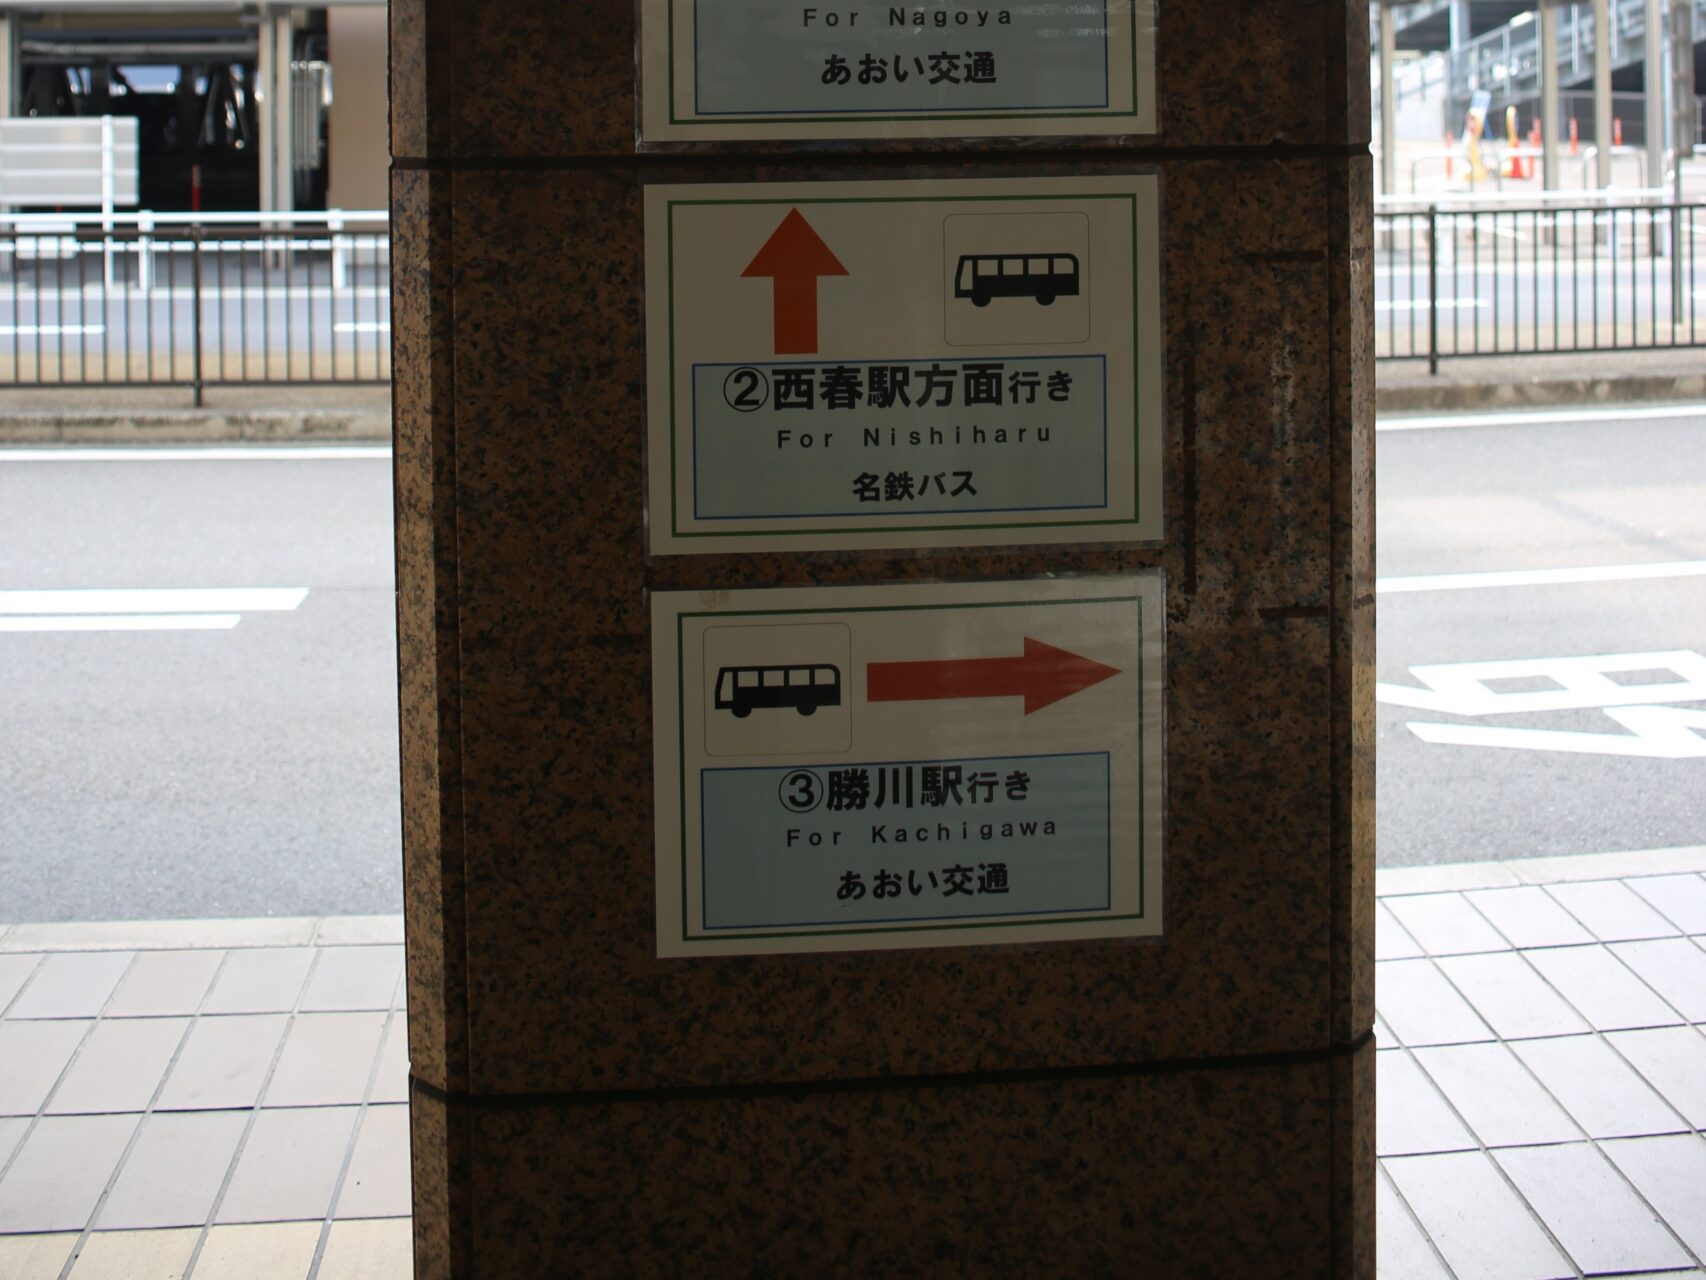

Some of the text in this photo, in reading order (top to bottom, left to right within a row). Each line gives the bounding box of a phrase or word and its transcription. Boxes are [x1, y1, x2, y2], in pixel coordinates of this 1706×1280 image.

[803, 7, 1011, 28] For Nagoya
[821, 50, 997, 86] あおい交通
[777, 425, 1050, 449] For Nishiharu
[852, 470, 978, 503] 名鉄バス
[786, 821, 1056, 848] For Kachigawa
[836, 862, 1010, 901] あおい交通
